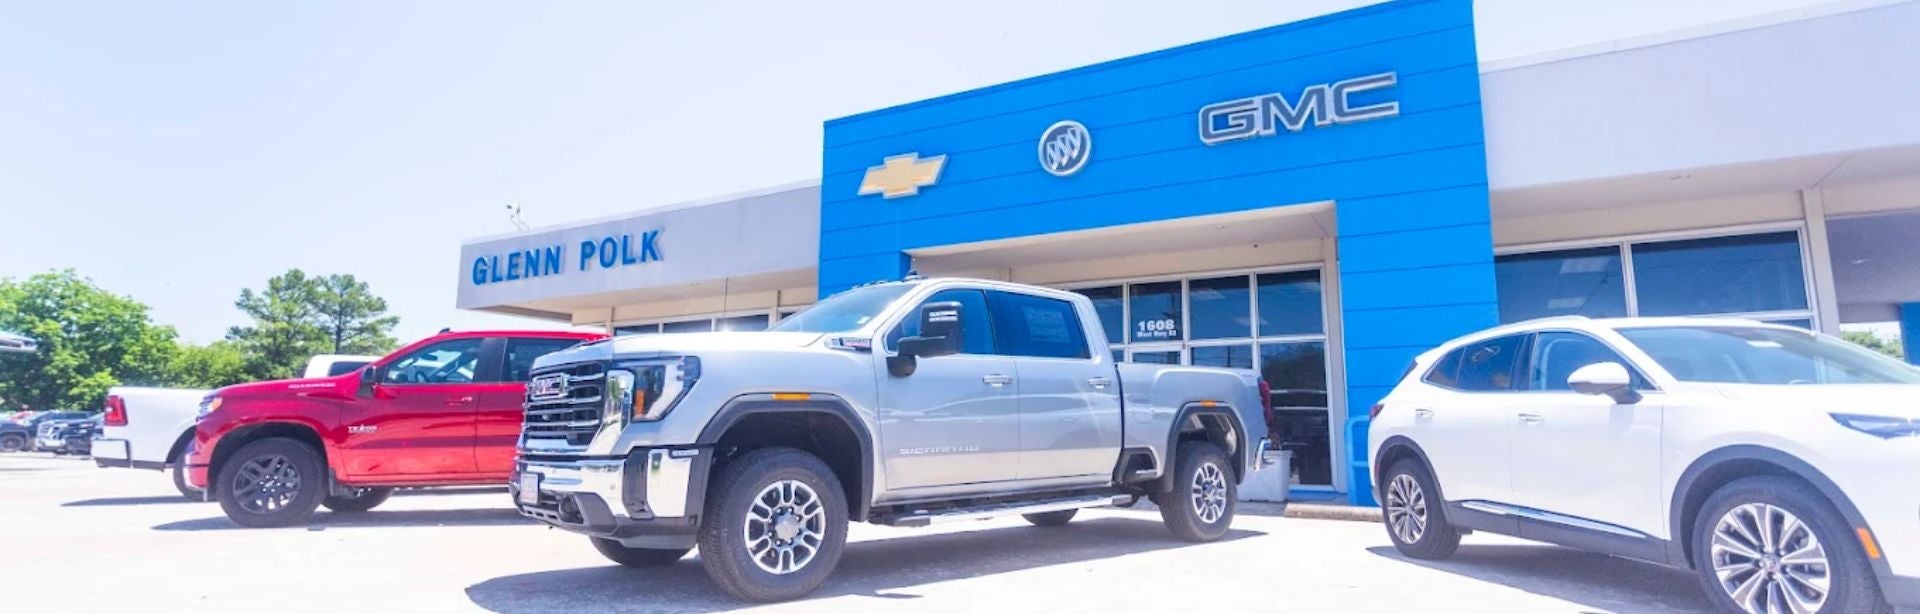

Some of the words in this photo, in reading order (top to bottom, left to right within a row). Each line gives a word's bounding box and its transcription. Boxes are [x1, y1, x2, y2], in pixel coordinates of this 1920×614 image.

[1199, 71, 1400, 145] GMC
[472, 244, 563, 286] GLENN
[579, 229, 664, 271] POLK
[1138, 319, 1175, 331] 1608
